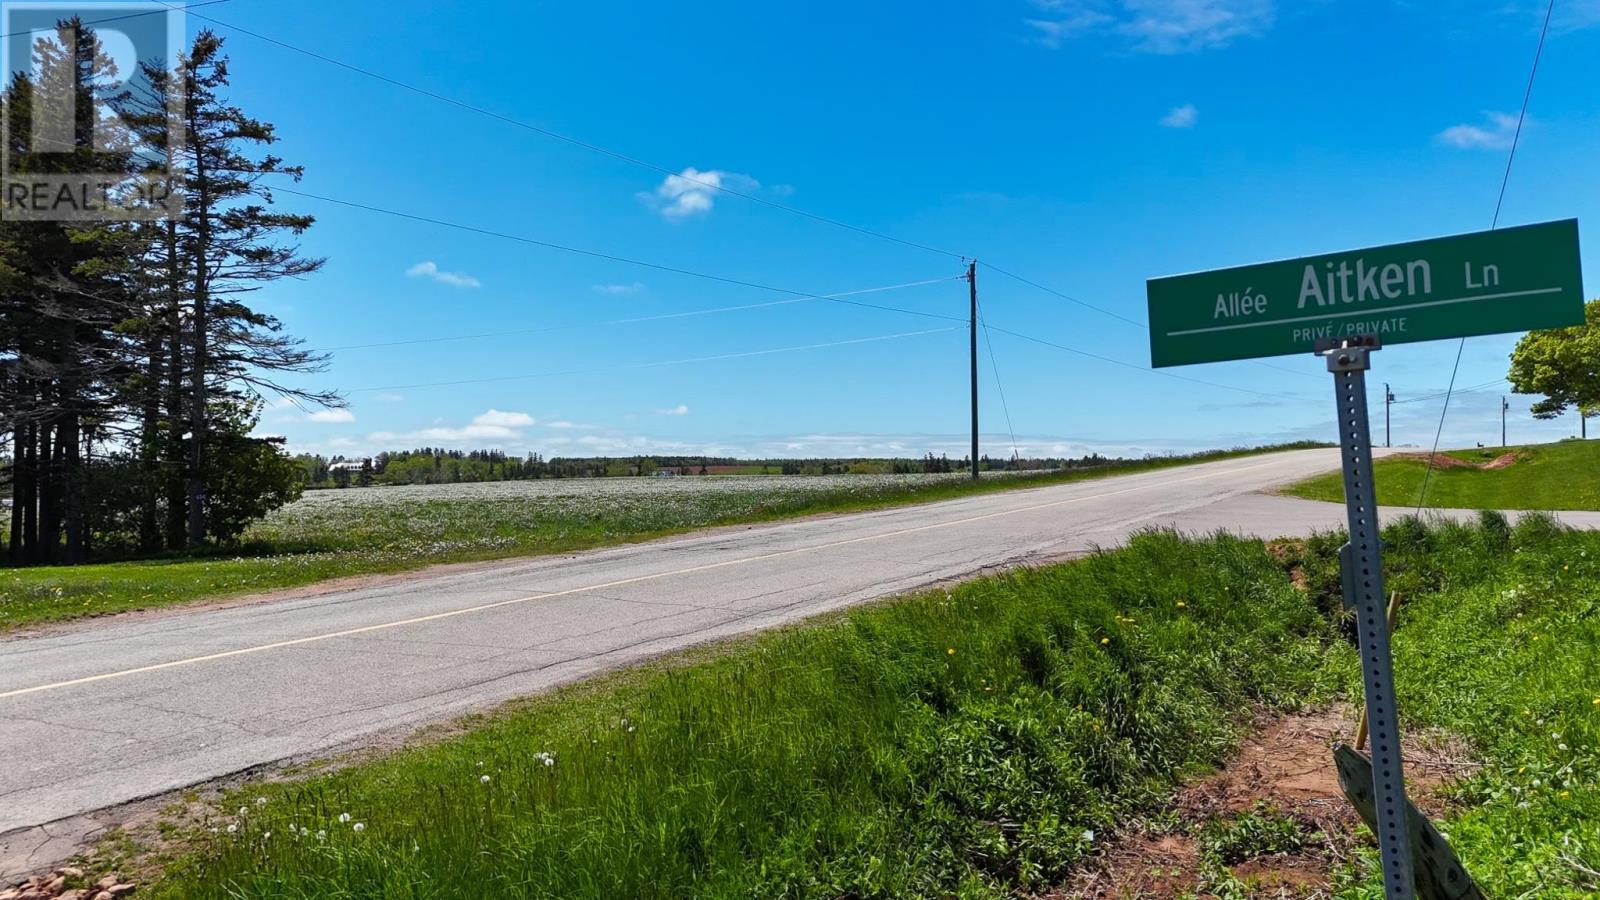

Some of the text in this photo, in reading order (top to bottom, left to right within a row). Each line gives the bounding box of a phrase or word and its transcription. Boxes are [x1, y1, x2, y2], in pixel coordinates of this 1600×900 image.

[1213, 258, 1500, 319] Allée Aitken Ln
